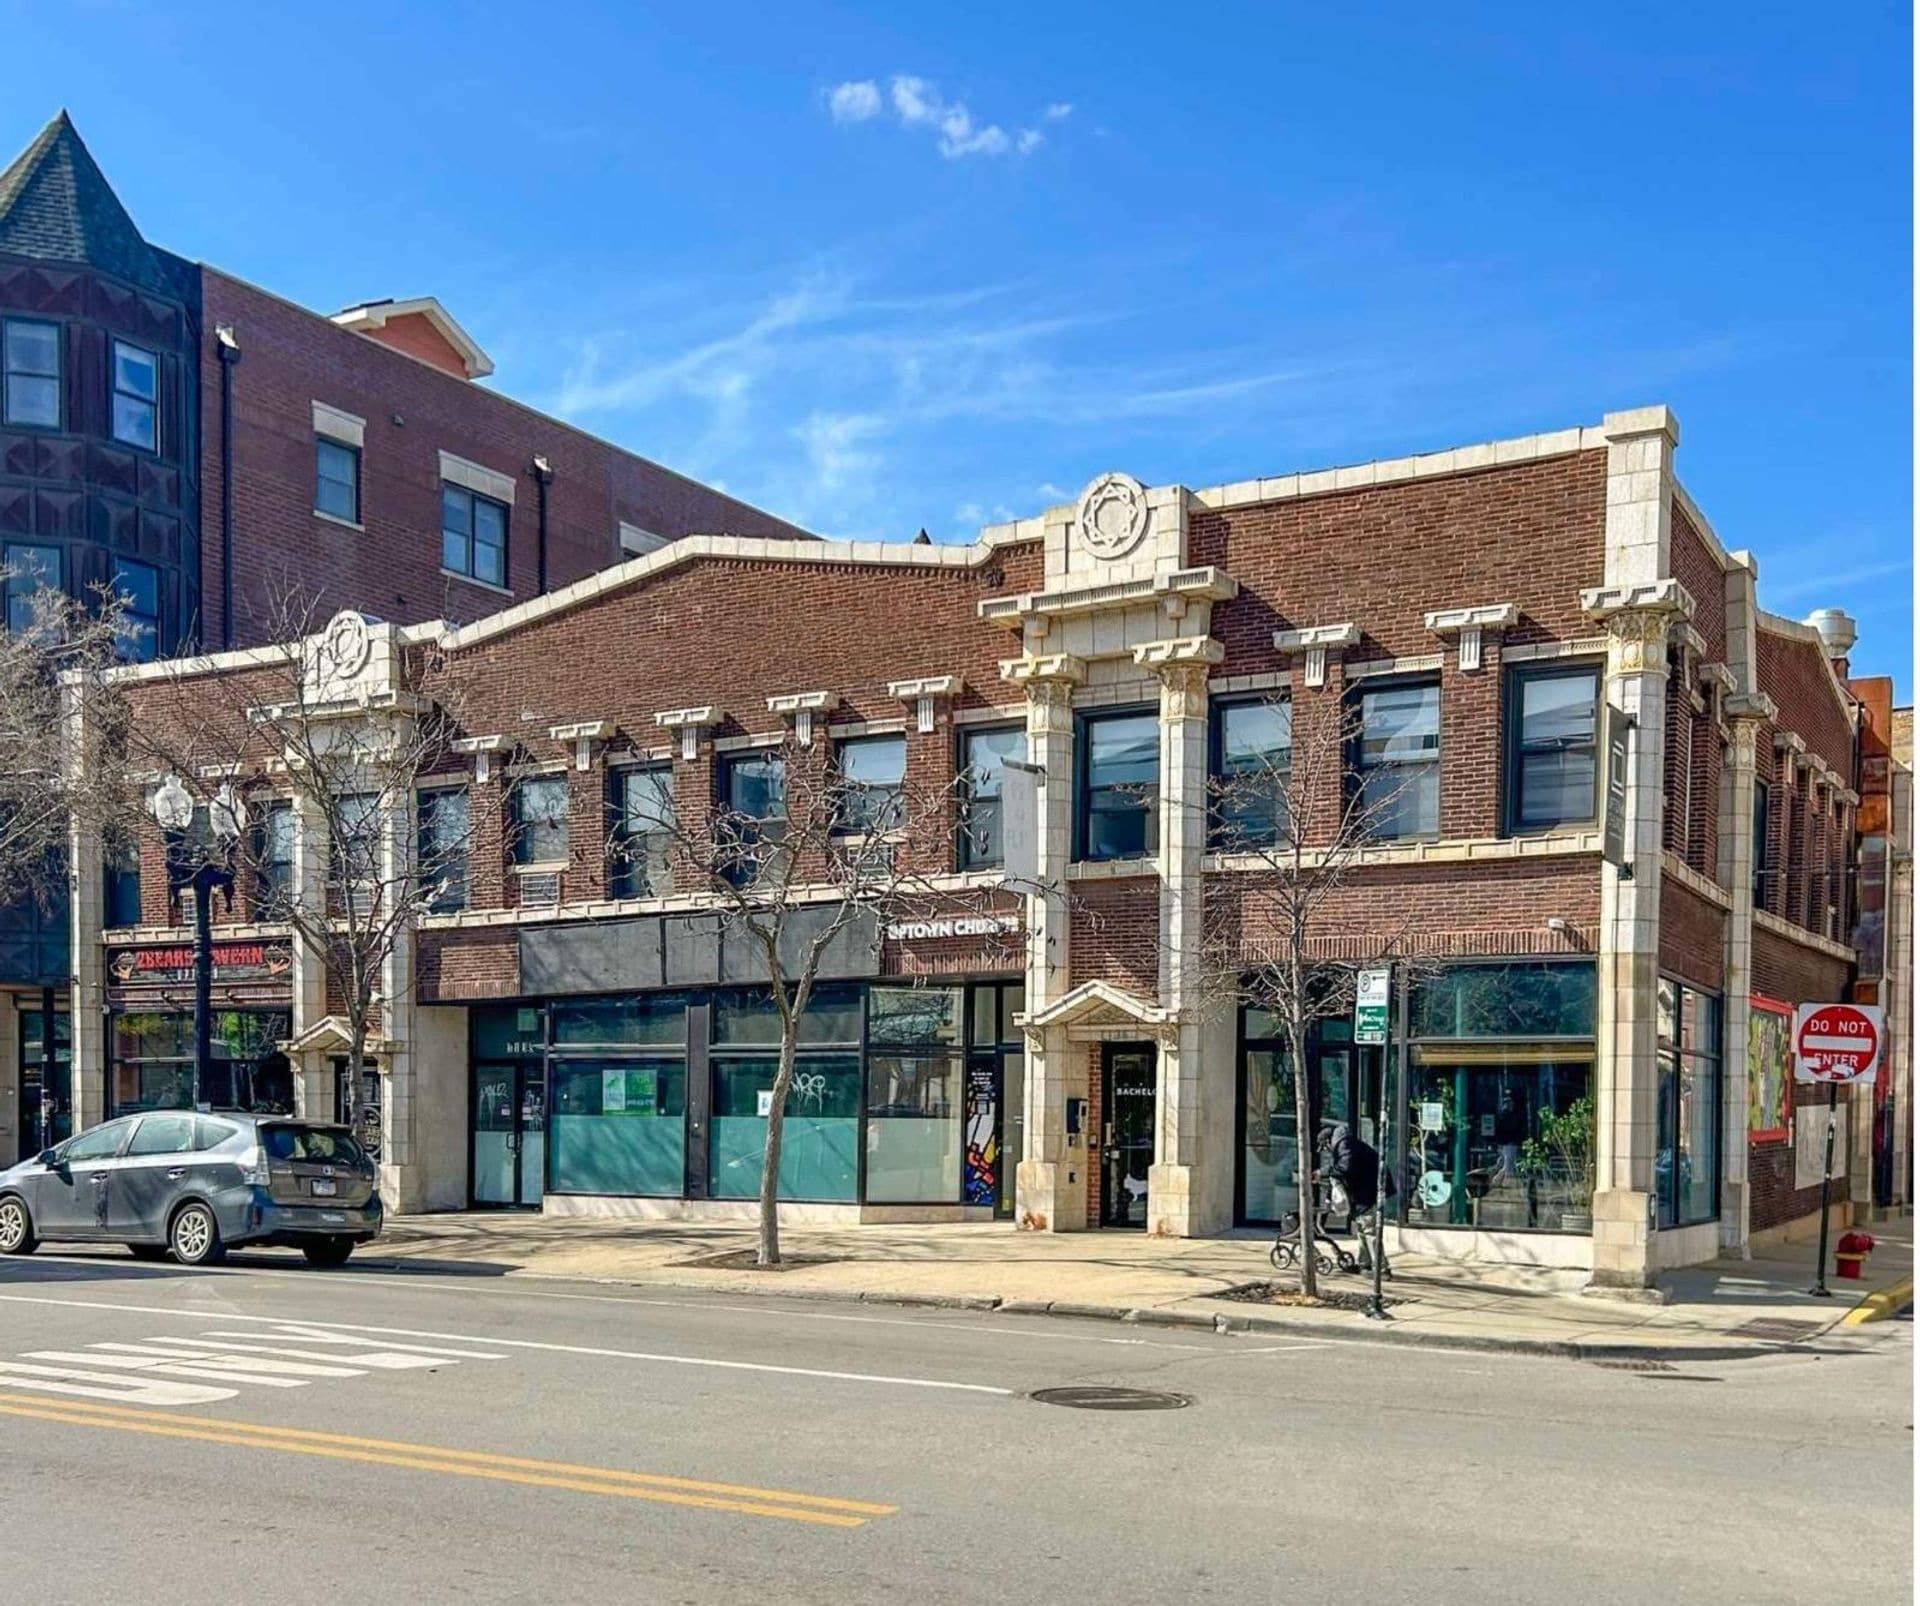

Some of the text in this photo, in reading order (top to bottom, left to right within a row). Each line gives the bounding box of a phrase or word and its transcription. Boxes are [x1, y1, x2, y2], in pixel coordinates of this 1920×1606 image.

[888, 920, 950, 940] UPTOWN
[211, 945, 264, 966] AVERN
[1810, 1019, 1867, 1033] DO NOT
